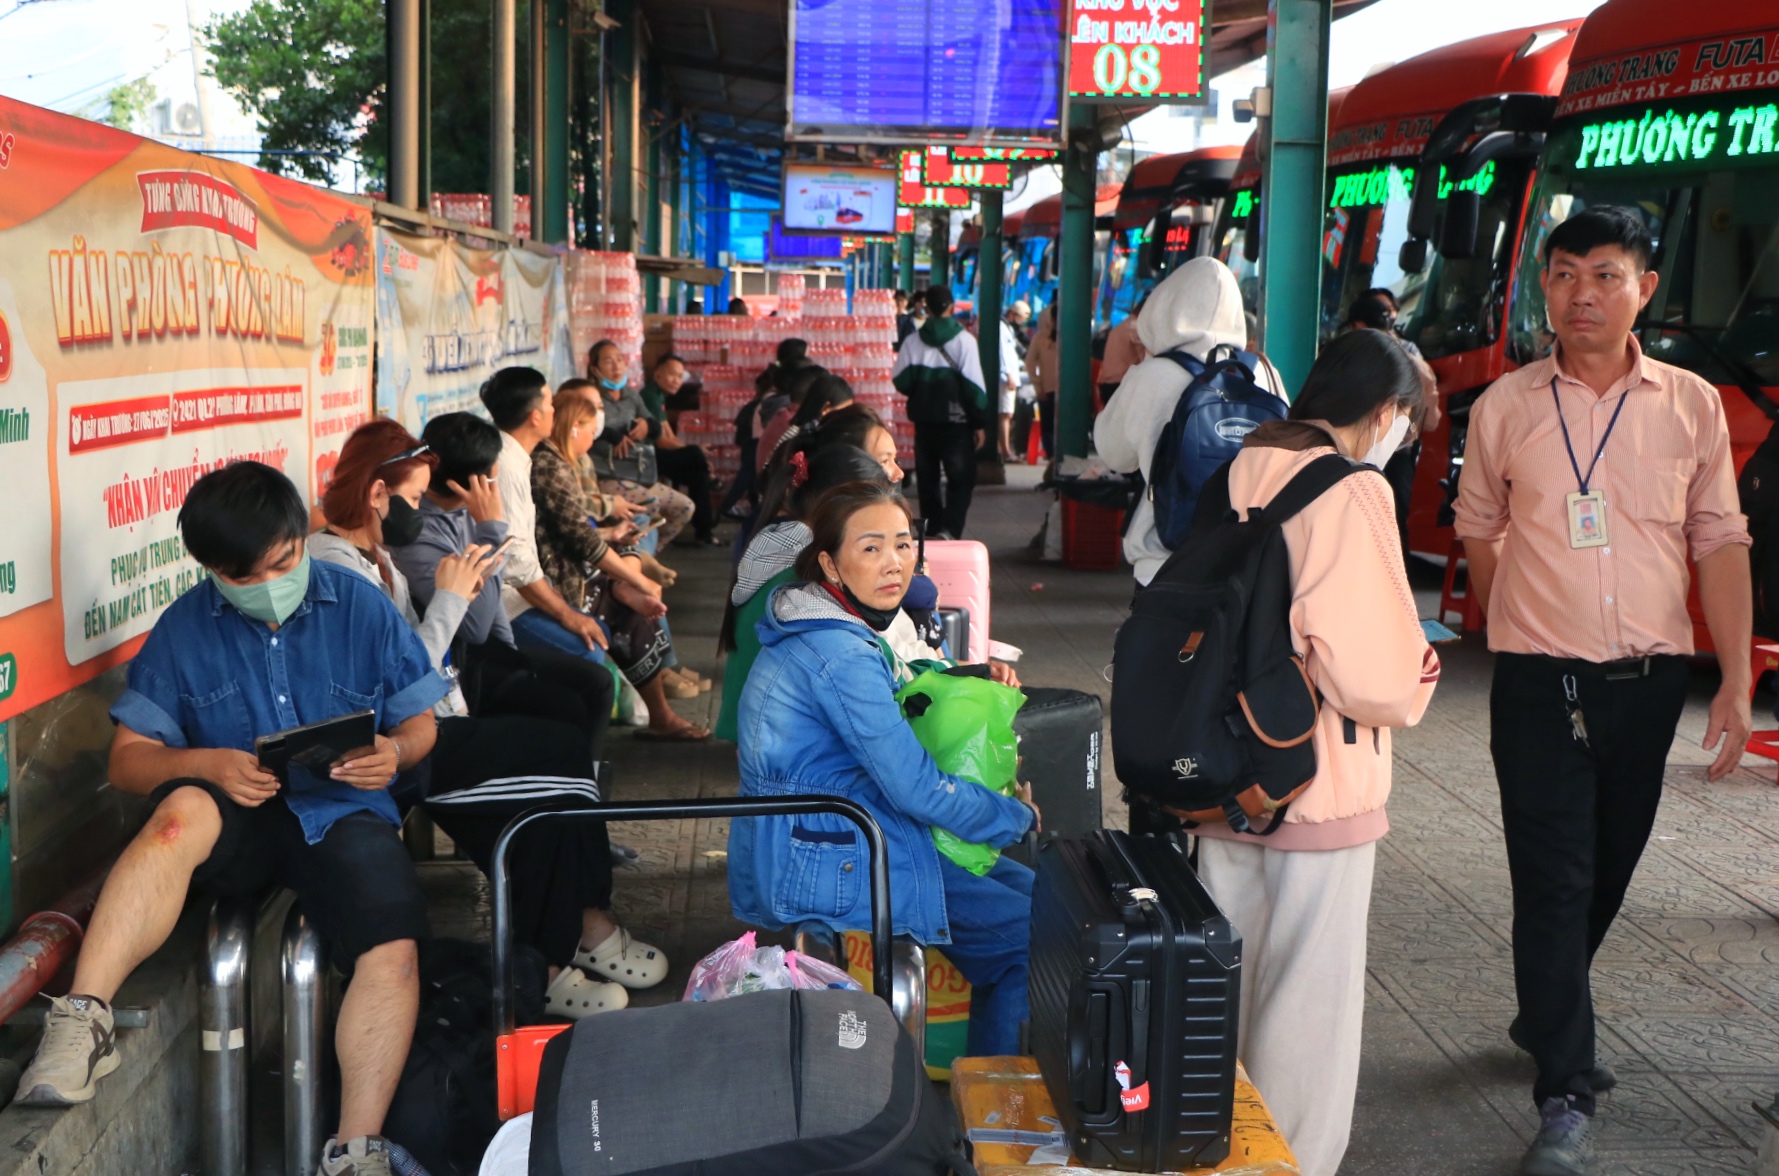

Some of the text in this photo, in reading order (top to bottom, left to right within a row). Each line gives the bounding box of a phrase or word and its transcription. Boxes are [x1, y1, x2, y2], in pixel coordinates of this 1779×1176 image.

[1114, 14, 1195, 45] KHÁCH
[1093, 43, 1161, 93] 08
[1618, 50, 1680, 83] TRANG
[1694, 37, 1765, 72] FUTA
[1576, 95, 1595, 111] XE
[1596, 82, 1632, 107] MIỀN
[1635, 81, 1670, 100] TÂY
[1688, 71, 1724, 93] BẾN
[1726, 72, 1752, 89] XE
[1395, 117, 1434, 140] FUTA
[1576, 103, 1779, 169] PHƯƠNG TR
[950, 164, 984, 184] 10
[49, 235, 113, 348] VĂN
[115, 239, 200, 340] PHÒNG
[111, 551, 137, 587] PHỤC
[149, 535, 180, 570] TRUNG
[84, 597, 107, 640] ĐẾN
[130, 583, 147, 619] CÁT
[838, 1012, 849, 1035] FACE
[847, 1009, 858, 1035] NORTH
[856, 1020, 867, 1036] THE
[591, 1099, 602, 1152] MERCURY 30
